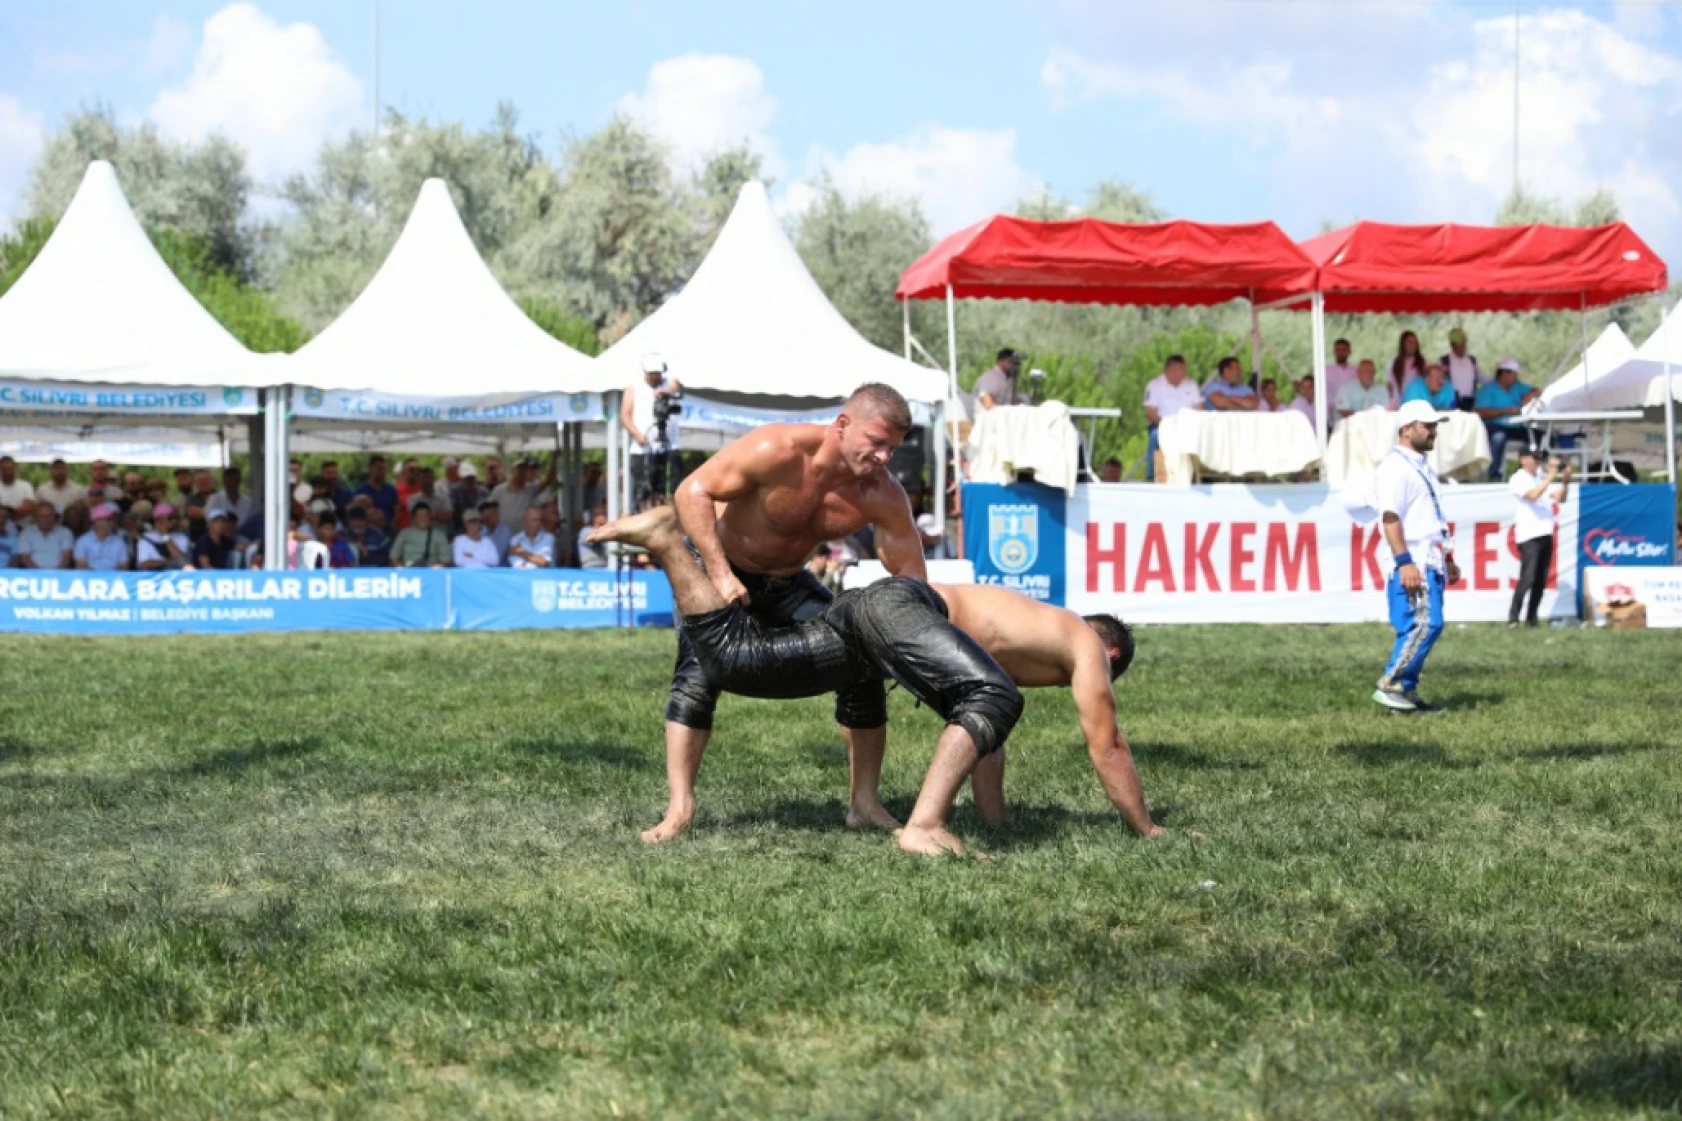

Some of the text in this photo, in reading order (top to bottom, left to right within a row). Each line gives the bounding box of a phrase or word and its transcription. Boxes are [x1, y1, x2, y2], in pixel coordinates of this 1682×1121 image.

[1085, 521, 1322, 592] HAKEM
[137, 578, 301, 604] BAŞARILAR
[308, 573, 421, 599] DİLERİM
